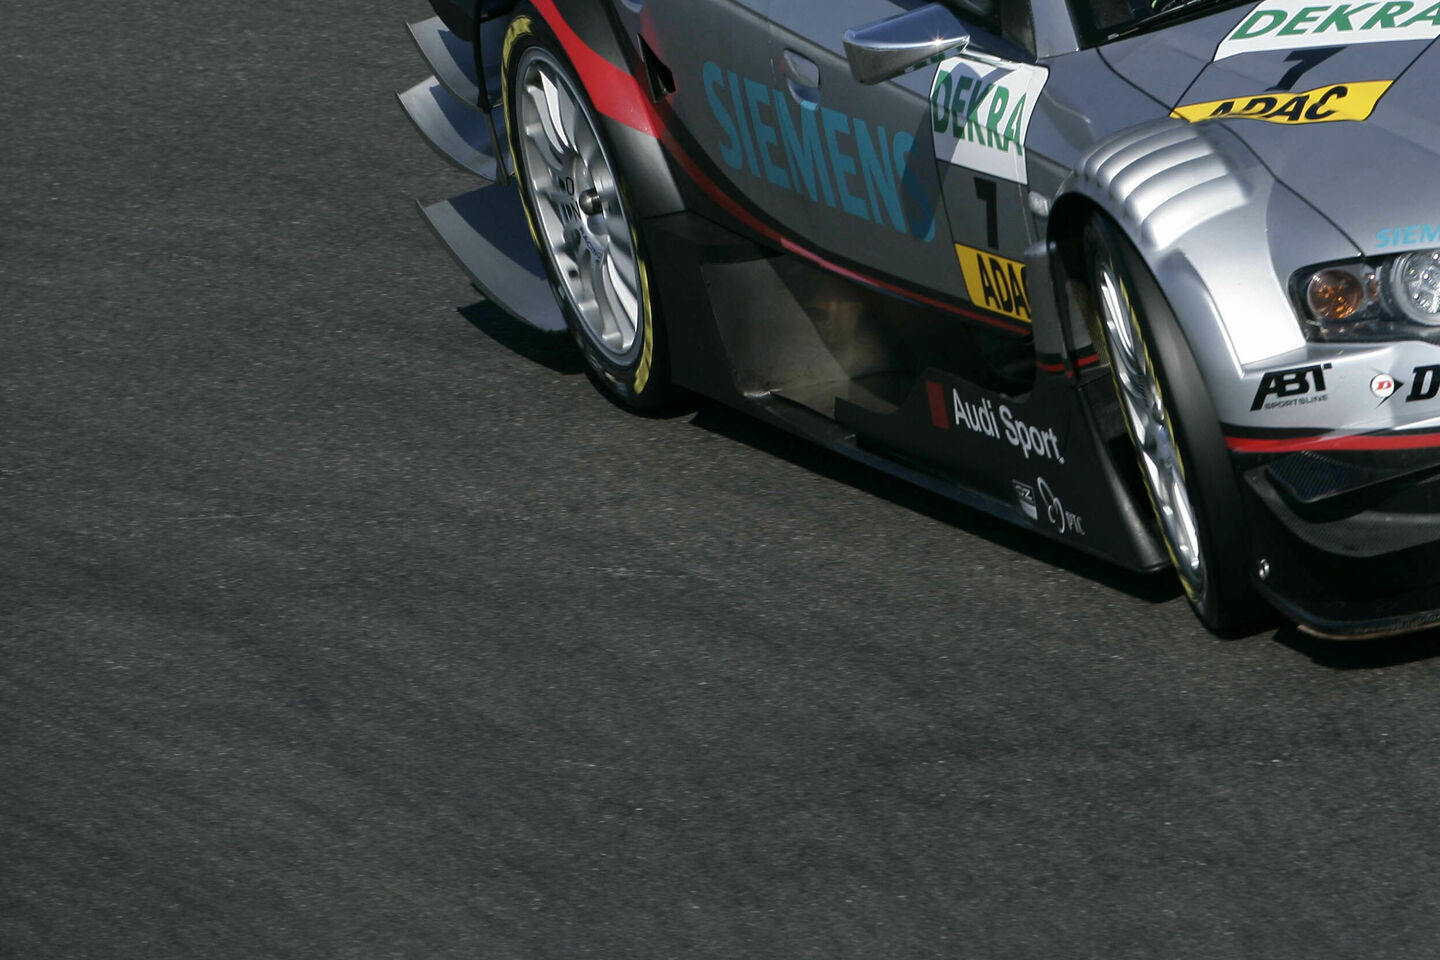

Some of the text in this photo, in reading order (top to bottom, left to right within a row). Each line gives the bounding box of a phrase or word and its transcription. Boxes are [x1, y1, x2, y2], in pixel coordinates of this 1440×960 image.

[702, 60, 936, 243] SIEMENS
[930, 70, 1027, 157] DEKRA
[952, 388, 1060, 459] Audi Sport
[1250, 363, 1332, 411] ABT
